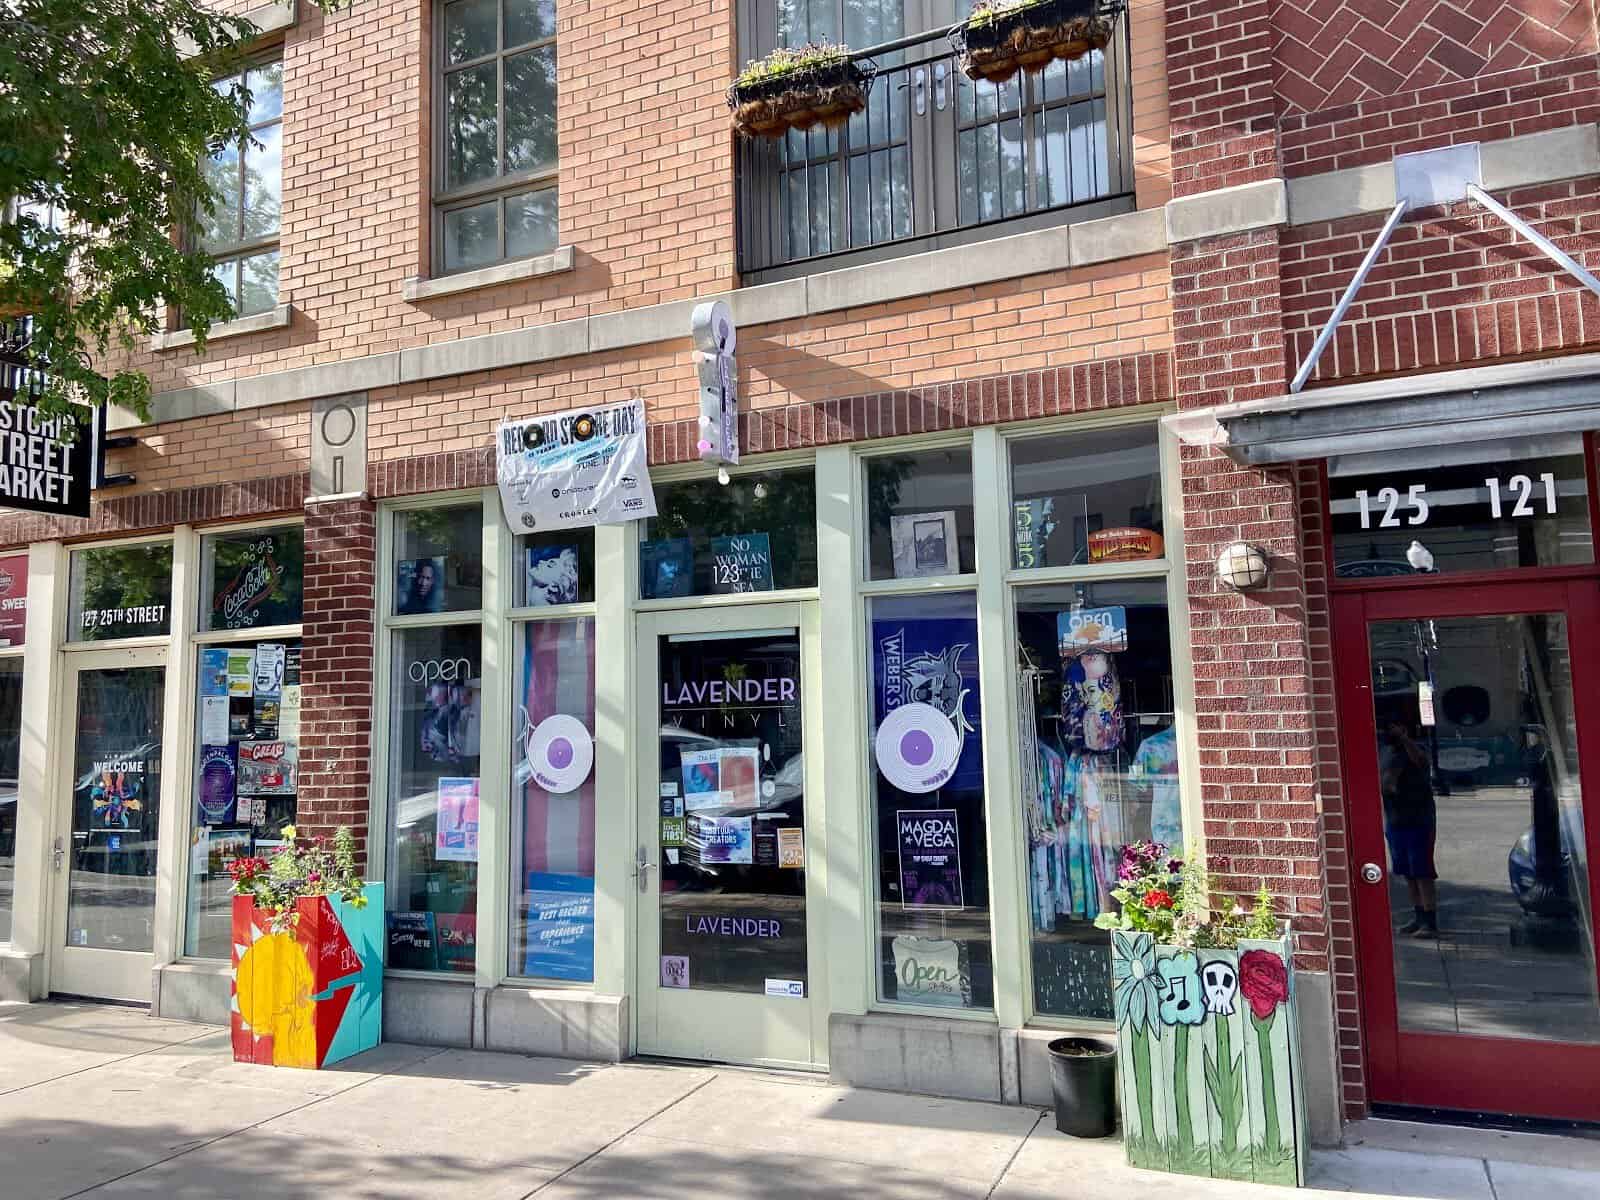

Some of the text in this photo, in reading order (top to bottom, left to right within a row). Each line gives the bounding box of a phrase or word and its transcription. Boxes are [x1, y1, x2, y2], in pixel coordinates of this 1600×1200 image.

[504, 420, 558, 456] RECORD
[560, 410, 611, 446] STORE
[613, 405, 637, 437] DAY
[1485, 472, 1557, 518] 121
[1355, 484, 1429, 529] 125
[730, 539, 750, 552] NO
[715, 552, 768, 567] WOMAN
[713, 565, 740, 585] 123
[81, 605, 165, 627] 127 25TH STREET
[1069, 612, 1113, 631] OPEN
[409, 658, 471, 688] open
[664, 678, 795, 704] LAVENDER
[672, 711, 787, 729] VINYL
[252, 743, 284, 760] GREASE
[94, 761, 143, 773] WELCOME
[901, 819, 955, 834] MAGDA
[913, 832, 955, 847] VEGA
[686, 915, 781, 938] LAVENDER
[901, 957, 958, 989] Open
